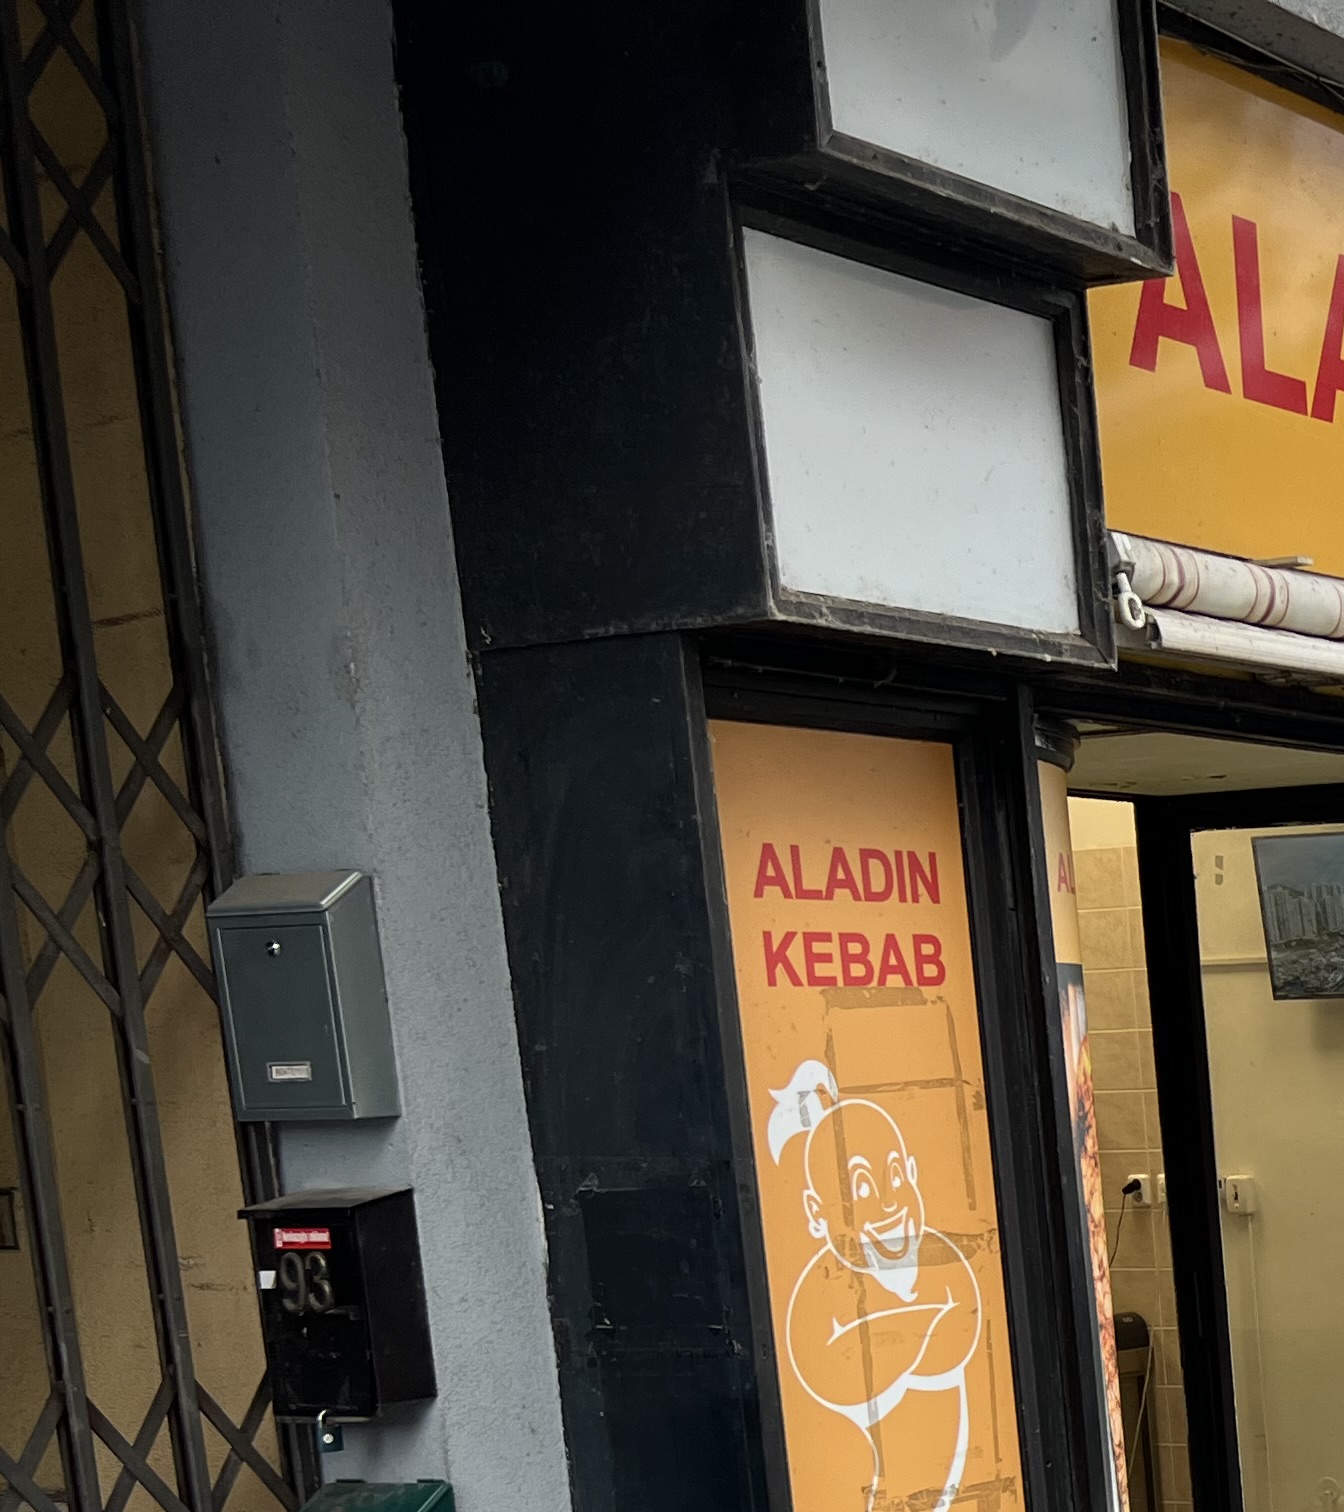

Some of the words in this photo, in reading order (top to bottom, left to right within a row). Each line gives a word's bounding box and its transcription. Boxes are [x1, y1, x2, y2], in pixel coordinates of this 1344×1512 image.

[753, 842, 941, 905] ALADIN
[762, 930, 947, 988] KEBAB
[280, 1251, 334, 1313] 93
